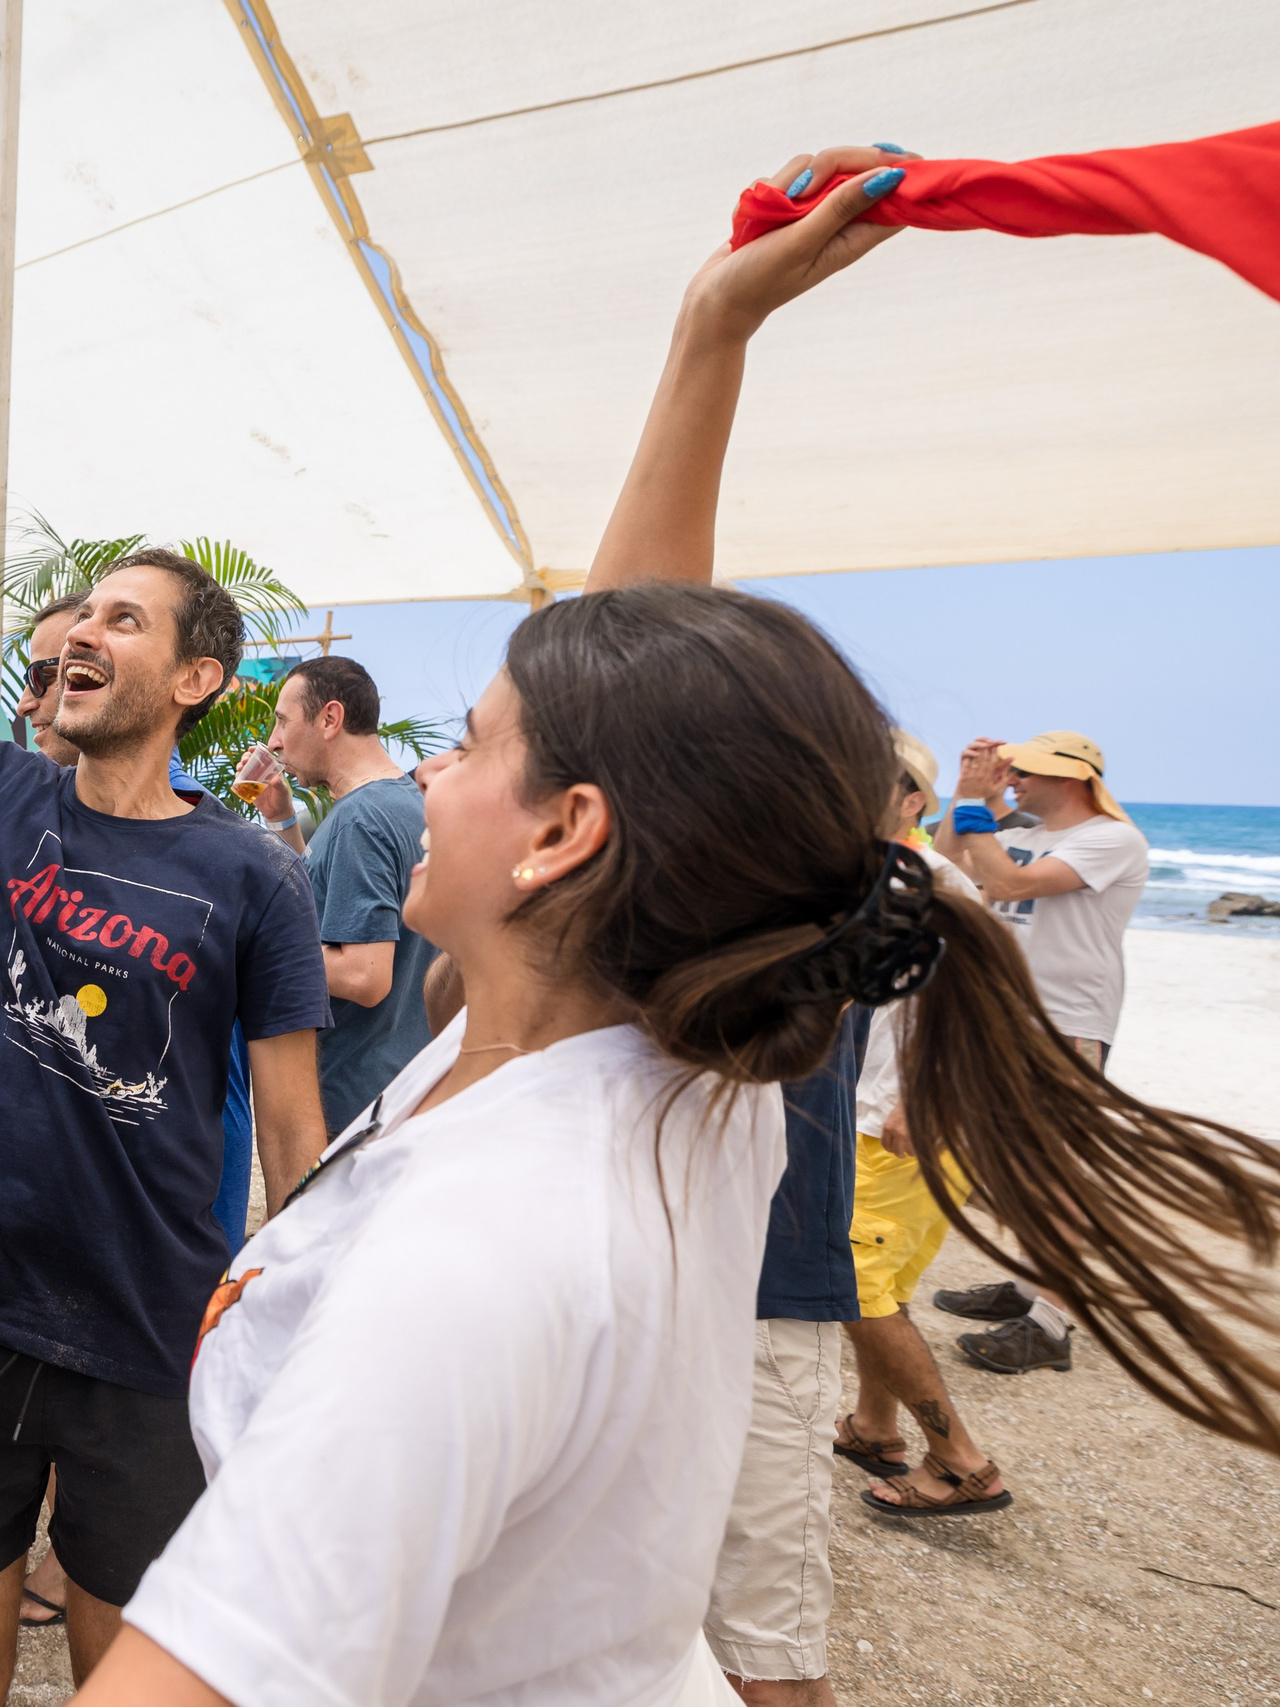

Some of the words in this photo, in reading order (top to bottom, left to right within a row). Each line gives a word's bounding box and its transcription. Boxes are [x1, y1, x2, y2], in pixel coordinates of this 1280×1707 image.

[7, 863, 197, 991] Arizona
[46, 936, 89, 967] NATIONAL
[94, 961, 129, 979] PARKS
